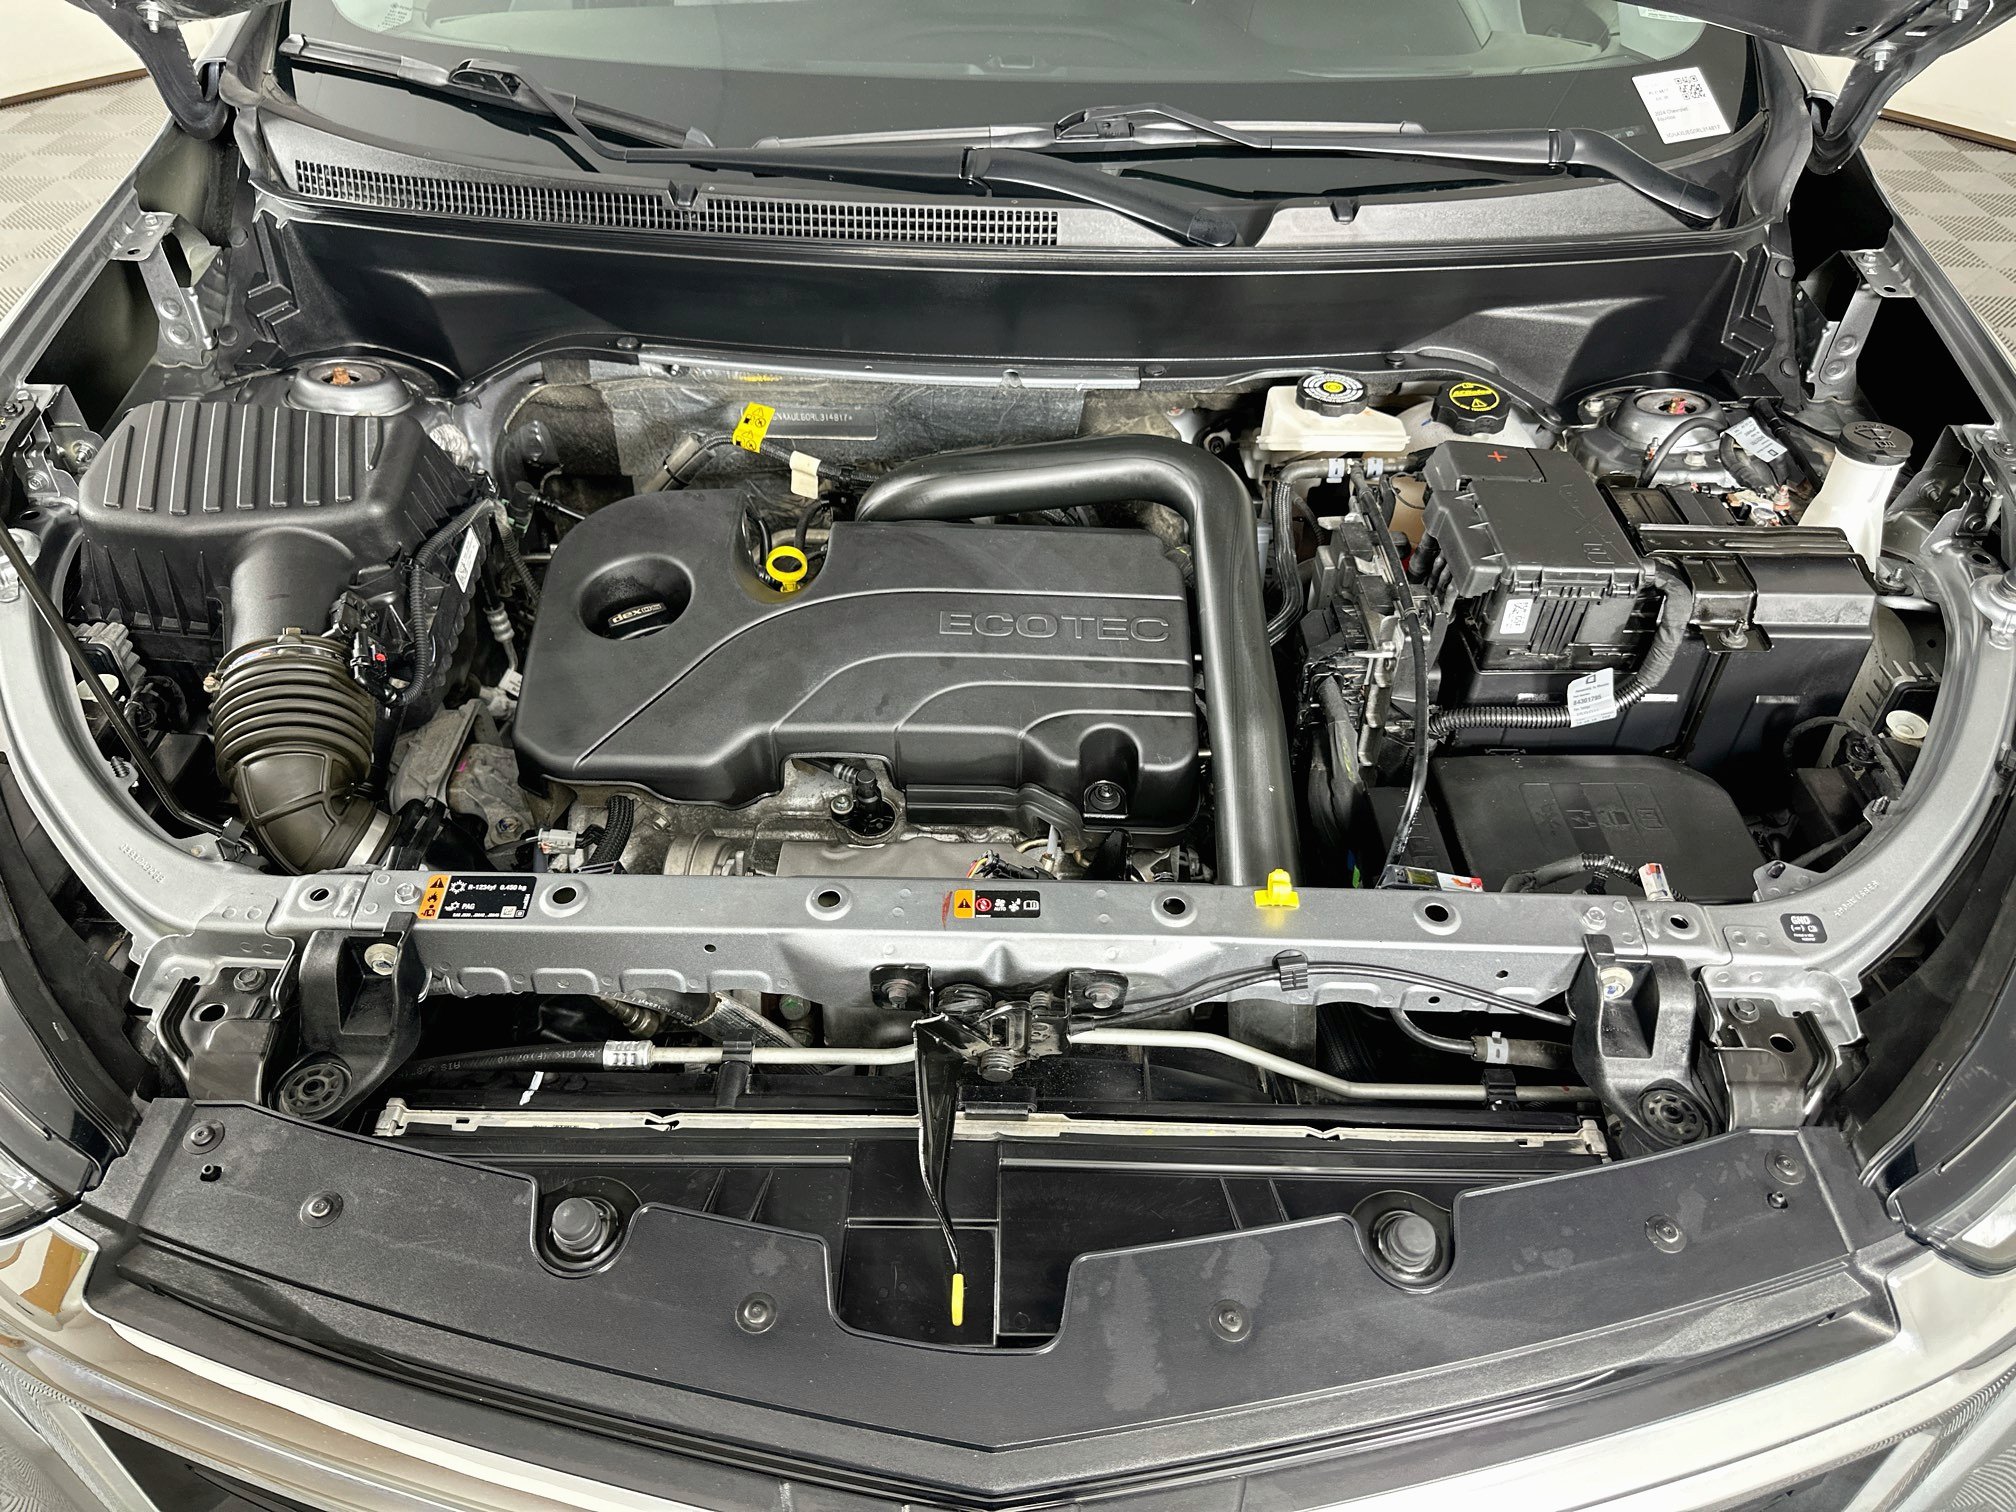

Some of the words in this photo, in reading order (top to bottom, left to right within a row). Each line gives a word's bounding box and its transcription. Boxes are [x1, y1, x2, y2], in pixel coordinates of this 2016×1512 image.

[939, 610, 1169, 642] ECOTEC
[467, 884, 497, 892] R-1234yf
[518, 884, 527, 892] kg
[1790, 915, 1811, 925] GND
